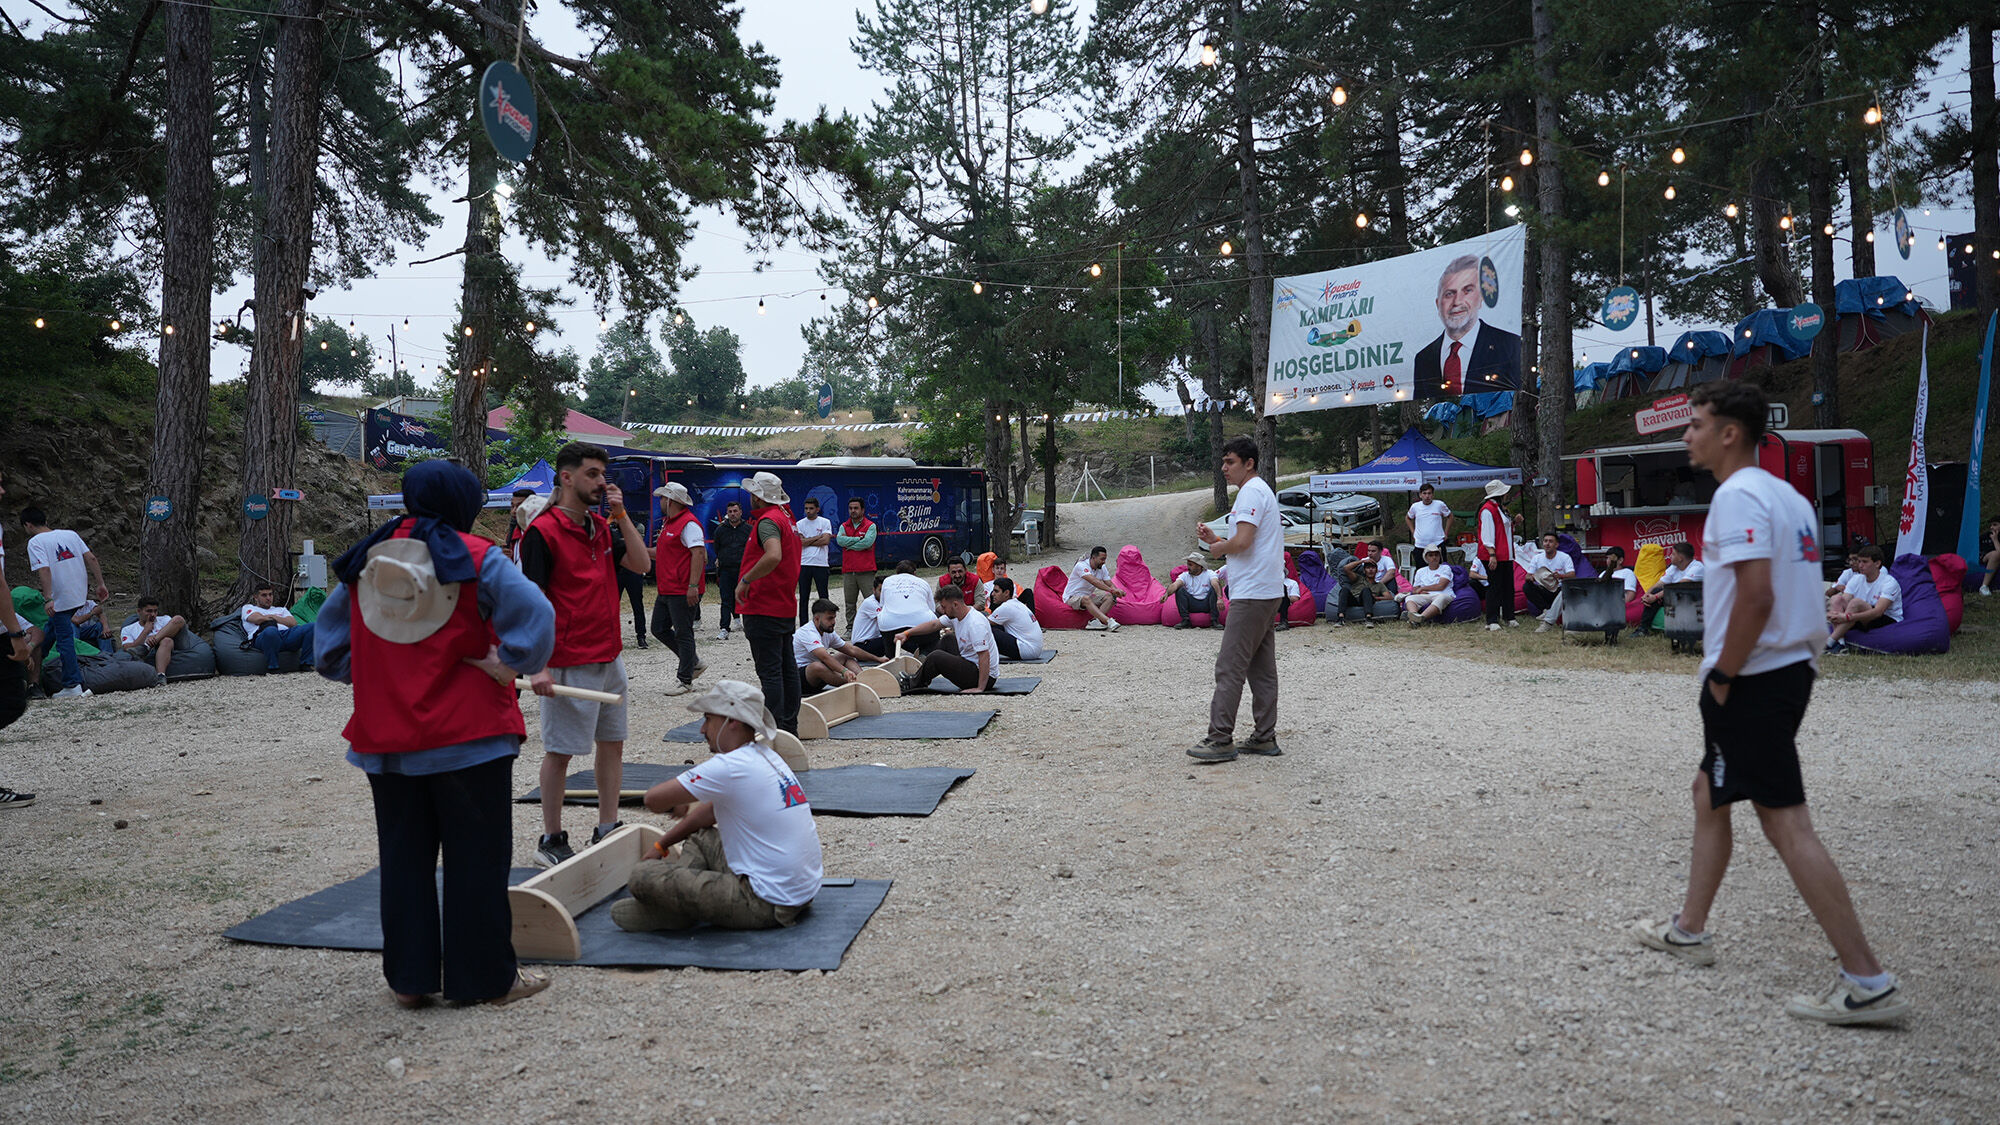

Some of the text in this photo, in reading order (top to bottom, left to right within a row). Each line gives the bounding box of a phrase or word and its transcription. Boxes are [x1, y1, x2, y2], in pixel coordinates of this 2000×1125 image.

[1330, 279, 1362, 297] pusula
[1299, 296, 1375, 327] KAMPLARI
[1273, 342, 1403, 381] HOŞGELDİNİZ
[907, 504, 932, 518] Bilim
[899, 516, 941, 533] Otobüsü
